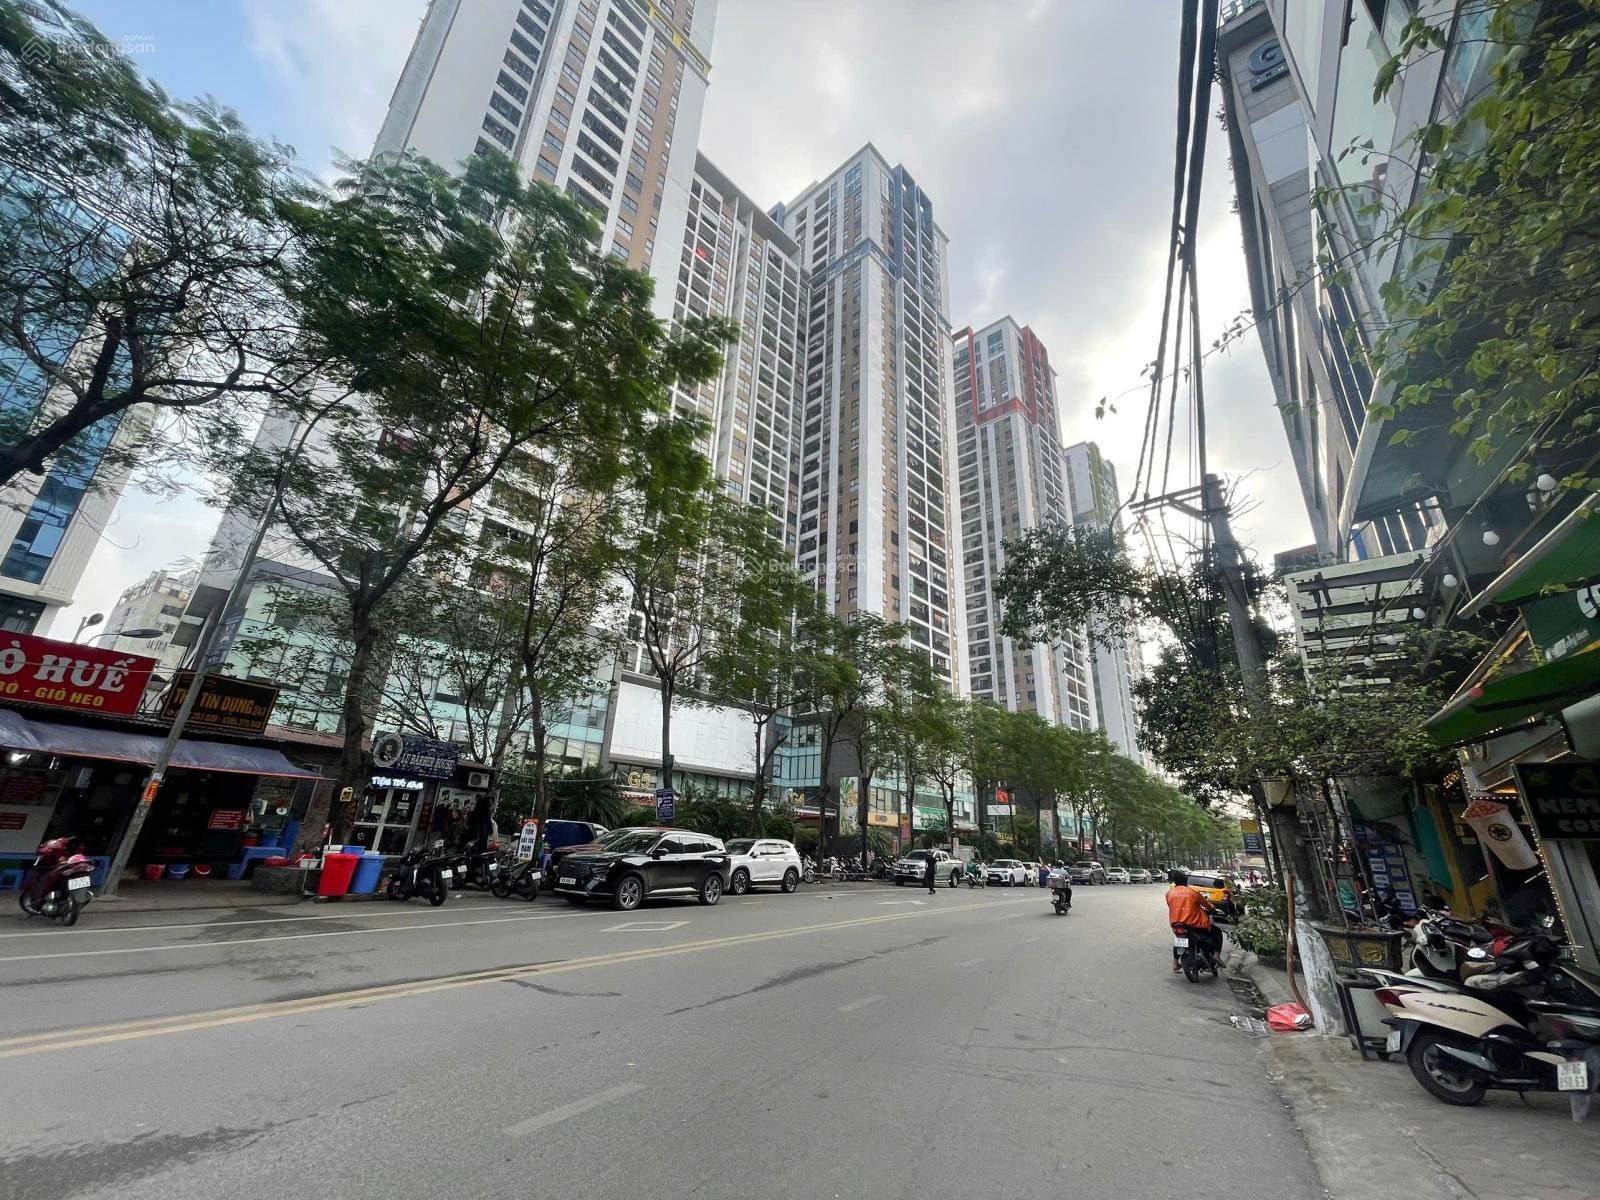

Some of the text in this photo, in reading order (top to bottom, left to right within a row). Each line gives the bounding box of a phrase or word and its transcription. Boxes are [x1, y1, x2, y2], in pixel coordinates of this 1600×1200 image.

[33, 657, 137, 693] HUẾ
[69, 692, 105, 707] HEO
[628, 771, 651, 790] G5
[657, 797, 663, 808] P
